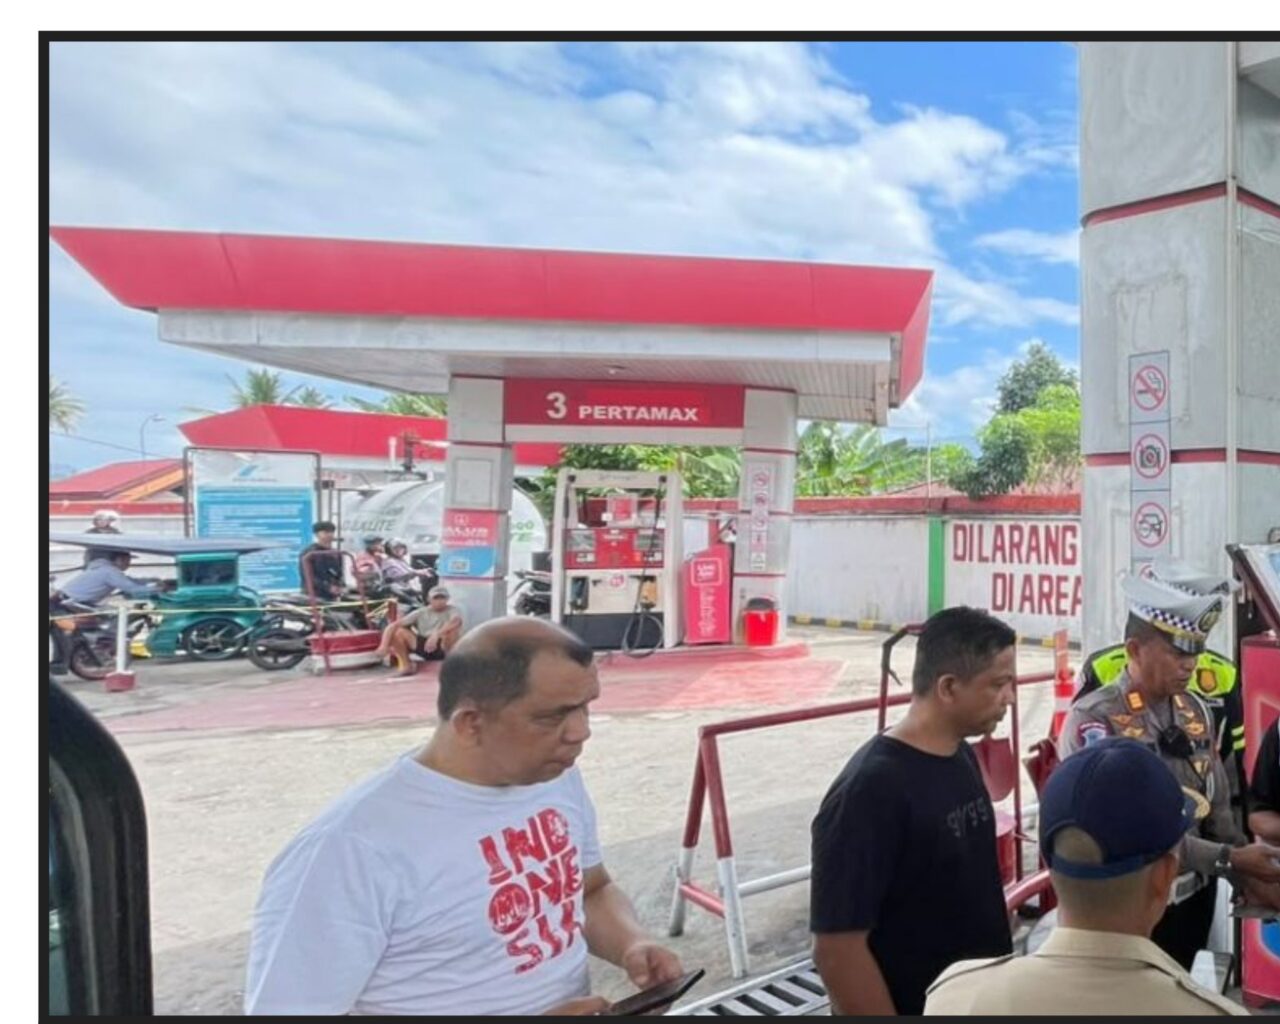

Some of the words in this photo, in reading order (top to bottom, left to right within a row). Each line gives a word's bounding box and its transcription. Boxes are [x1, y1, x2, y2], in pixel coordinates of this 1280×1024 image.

[546, 392, 567, 419] 3
[578, 405, 699, 421] PERTAMAX
[953, 523, 1078, 566] DILARANG
[992, 572, 1015, 612] DI
